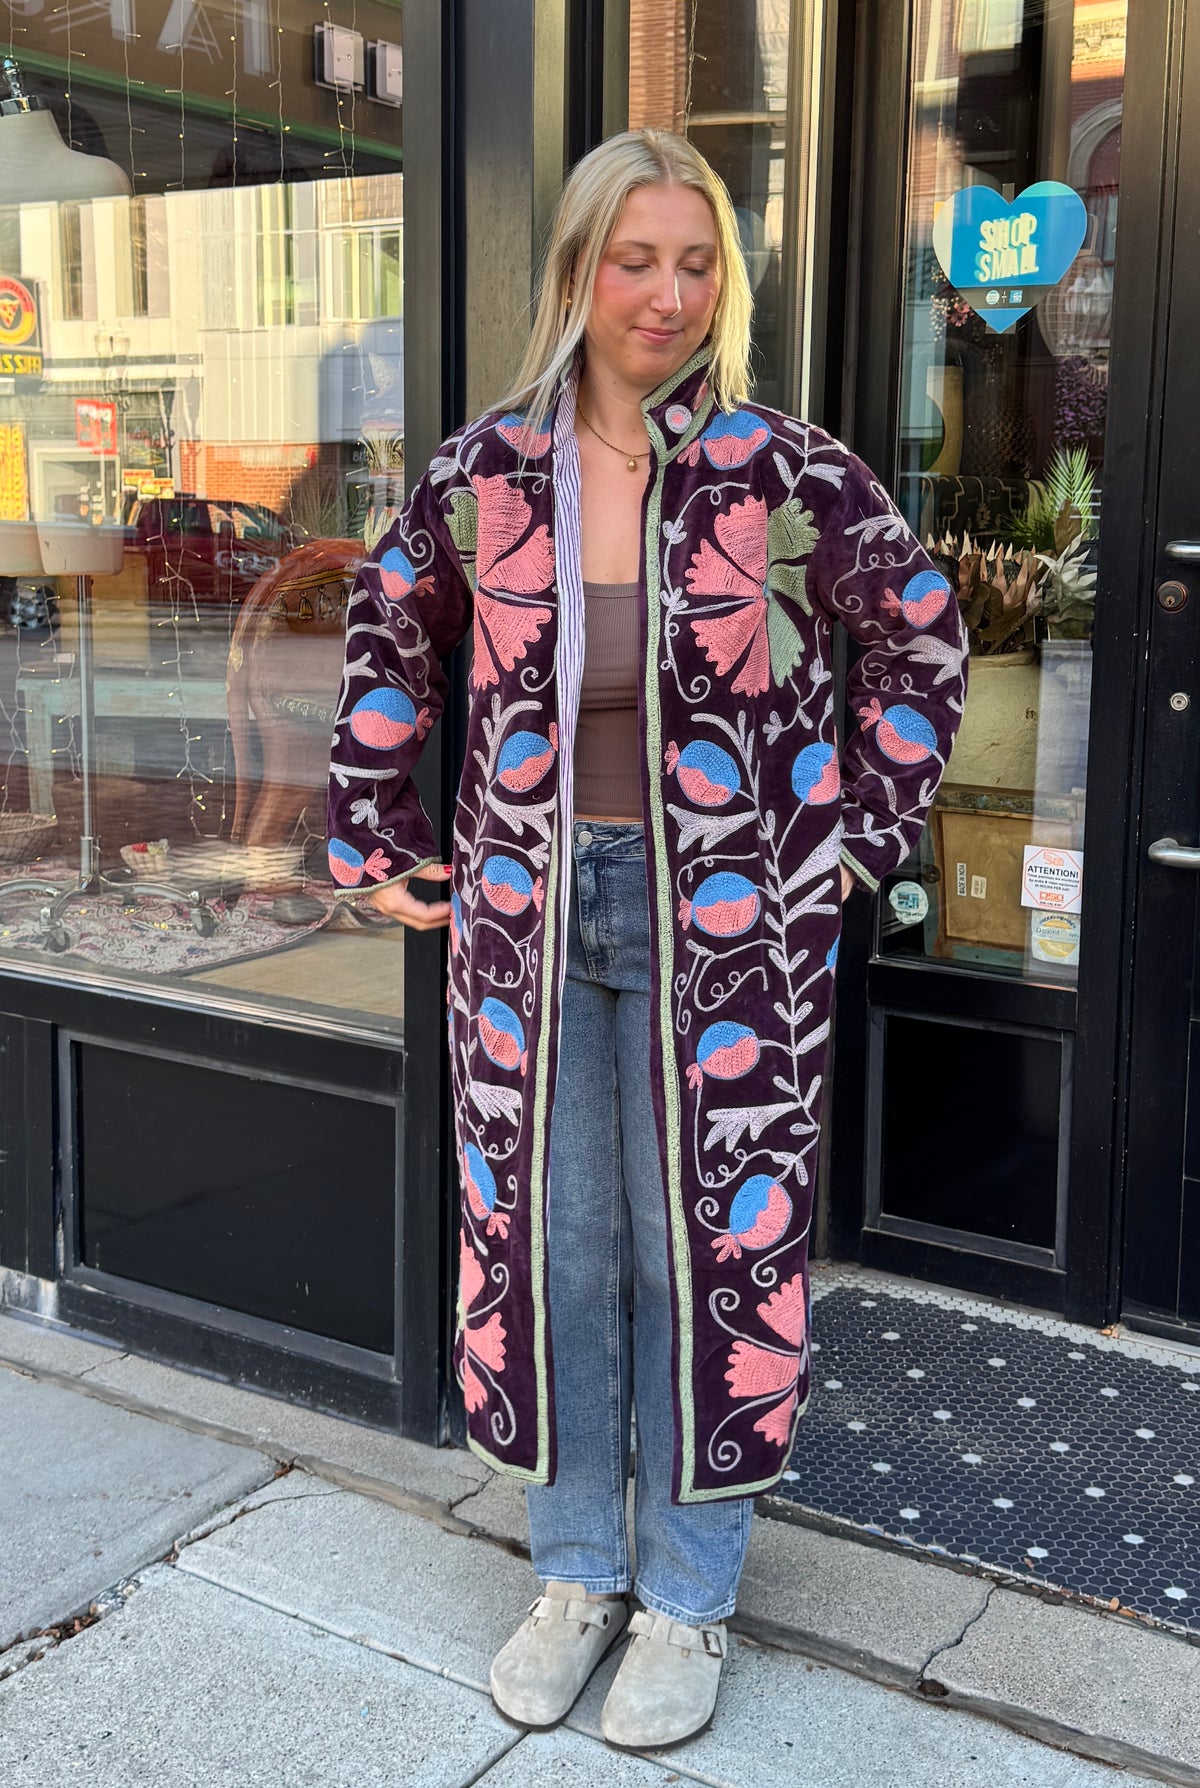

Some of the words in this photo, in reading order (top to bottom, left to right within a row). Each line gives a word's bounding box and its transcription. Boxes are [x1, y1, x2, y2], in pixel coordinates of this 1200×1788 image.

[980, 212, 1037, 251] SHOP
[976, 244, 1039, 282] SMALL
[1028, 865, 1079, 879] ATTENTION!
